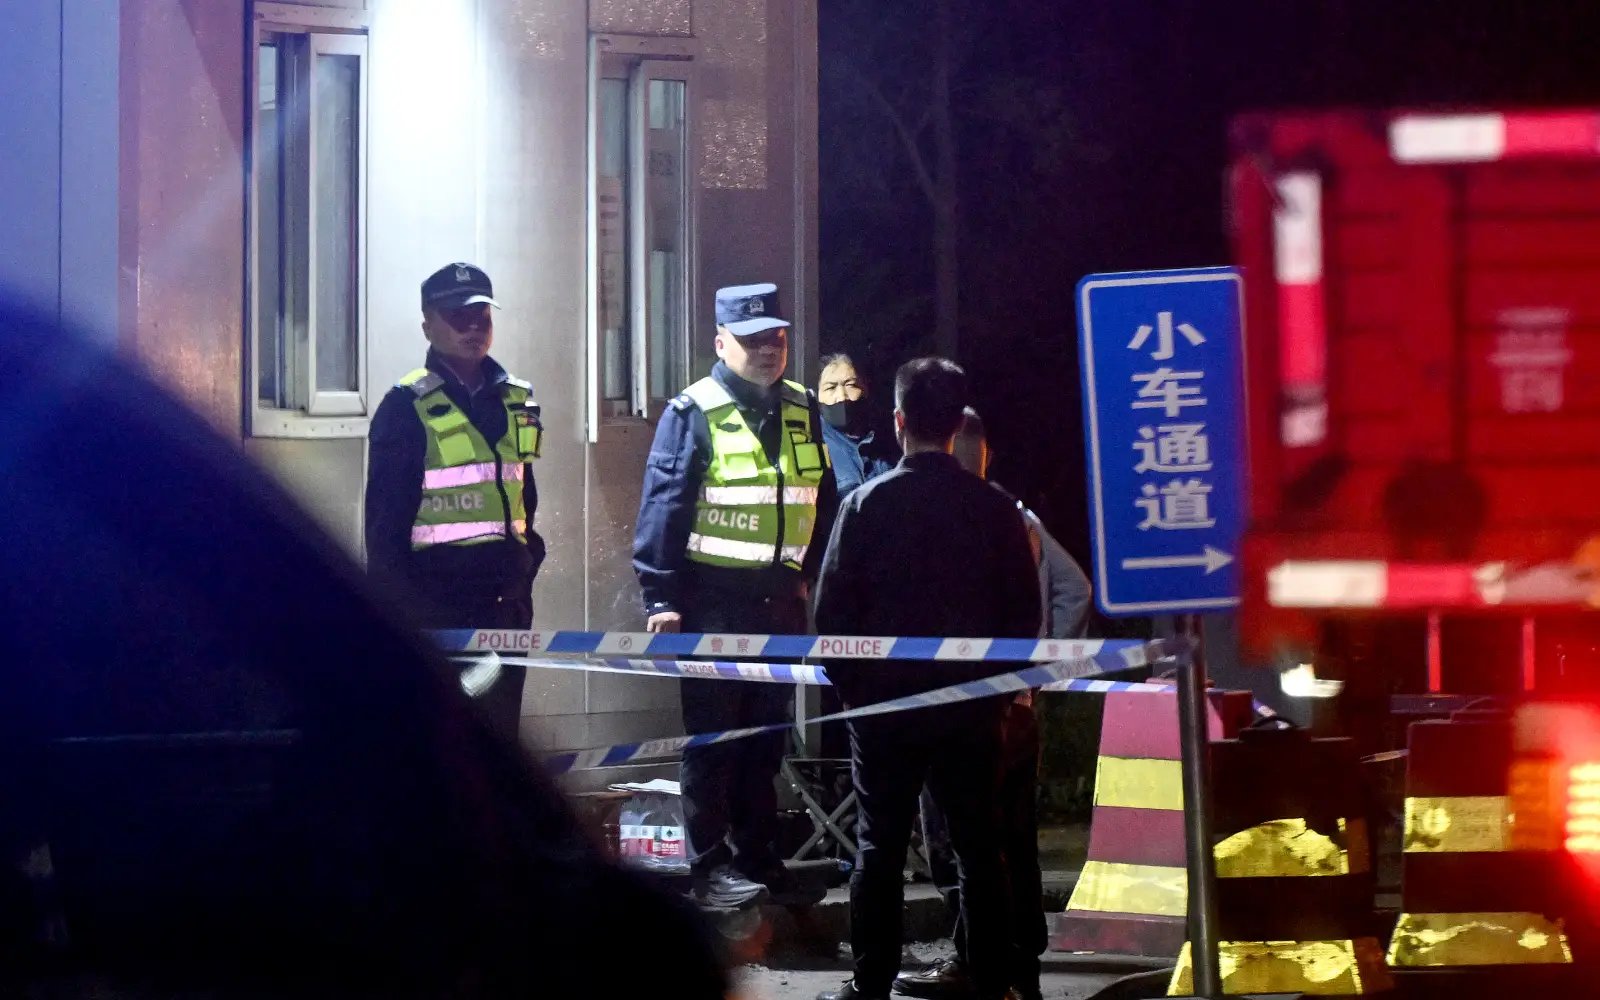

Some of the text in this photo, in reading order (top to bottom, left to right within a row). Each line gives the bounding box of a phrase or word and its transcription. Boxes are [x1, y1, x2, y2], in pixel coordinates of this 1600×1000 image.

[1127, 311, 1216, 530] 小车通道
[420, 491, 485, 513] POLICE
[477, 632, 541, 649] POLICE
[820, 638, 882, 655] POLICE
